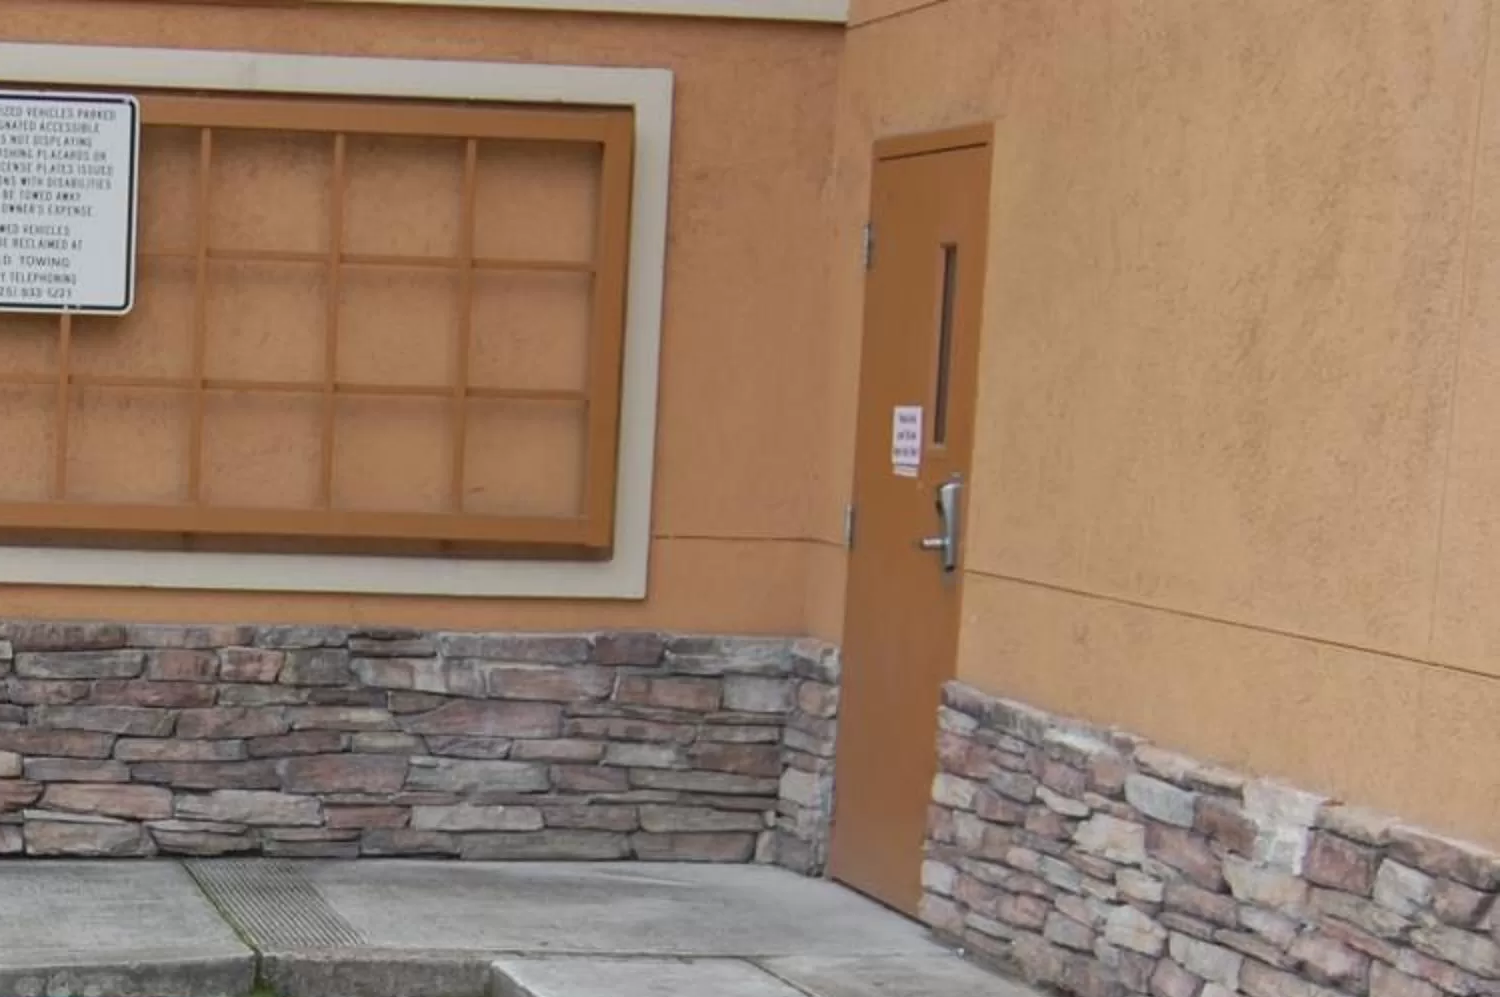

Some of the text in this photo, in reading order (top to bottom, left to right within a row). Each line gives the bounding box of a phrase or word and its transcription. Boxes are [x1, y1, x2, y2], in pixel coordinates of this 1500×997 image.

[27, 106, 74, 119] VEHICLES
[77, 108, 117, 121] PARKED
[10, 134, 29, 145] NOT
[33, 135, 92, 148] DISPLAYING
[37, 149, 90, 161] PLACARDS
[92, 151, 107, 162] OR
[36, 163, 74, 175] PLATES
[20, 176, 43, 187] WITH
[2, 189, 14, 200] BE
[19, 190, 51, 201] TOWED
[56, 191, 81, 201] AWAY
[48, 204, 92, 217] EXPENSE
[23, 223, 70, 236] VEHICLES
[12, 238, 68, 250] RECLAIMED
[71, 240, 83, 251] AT
[20, 255, 70, 268] TOWING
[10, 271, 77, 285] TELEPHONING
